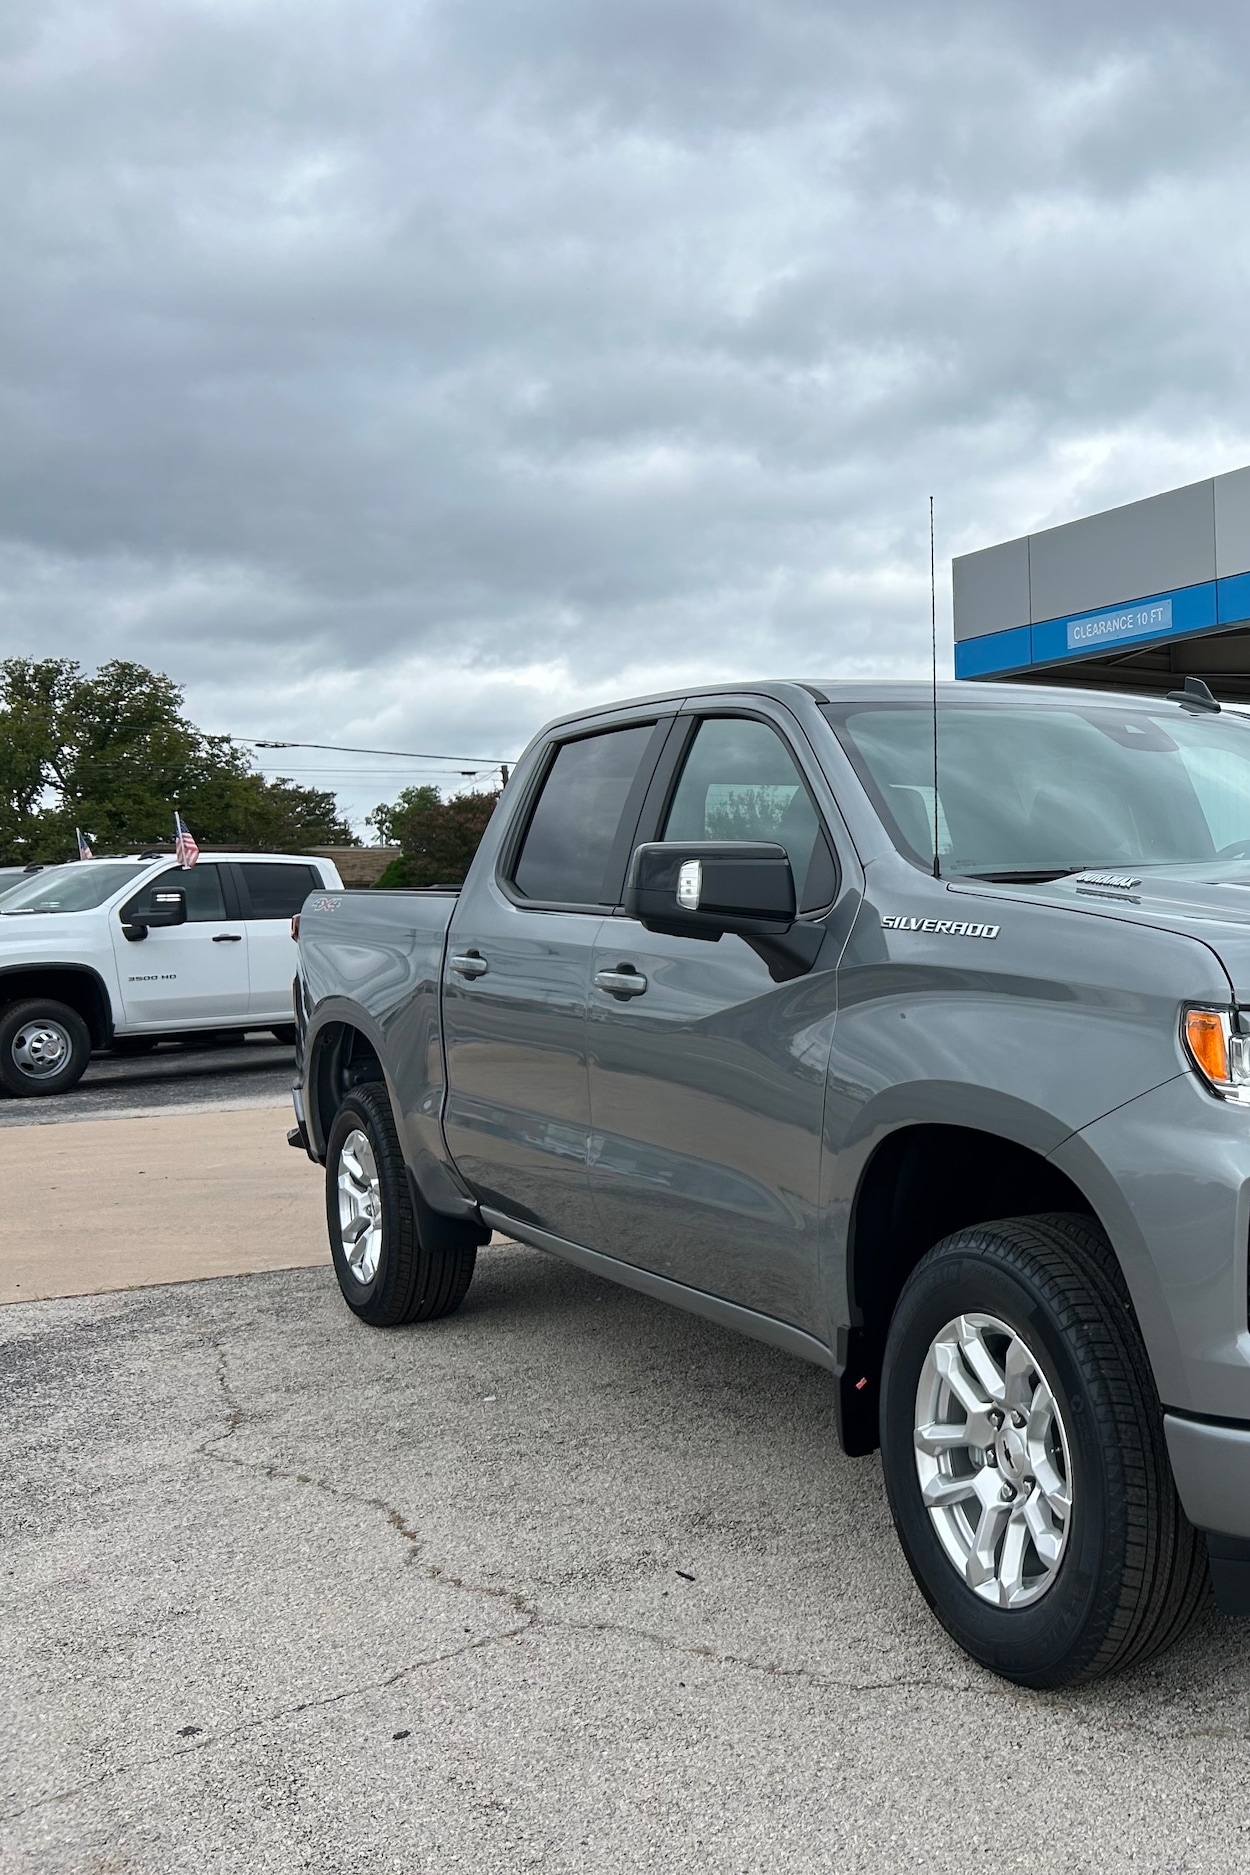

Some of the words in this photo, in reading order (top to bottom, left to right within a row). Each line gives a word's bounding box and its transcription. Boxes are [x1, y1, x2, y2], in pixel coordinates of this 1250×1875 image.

[1073, 614, 1134, 640] CLEARANCE
[1136, 612, 1148, 626] 10
[1150, 608, 1163, 623] FT
[1076, 873, 1142, 889] DURAMAX
[881, 915, 1001, 939] SILVERADO
